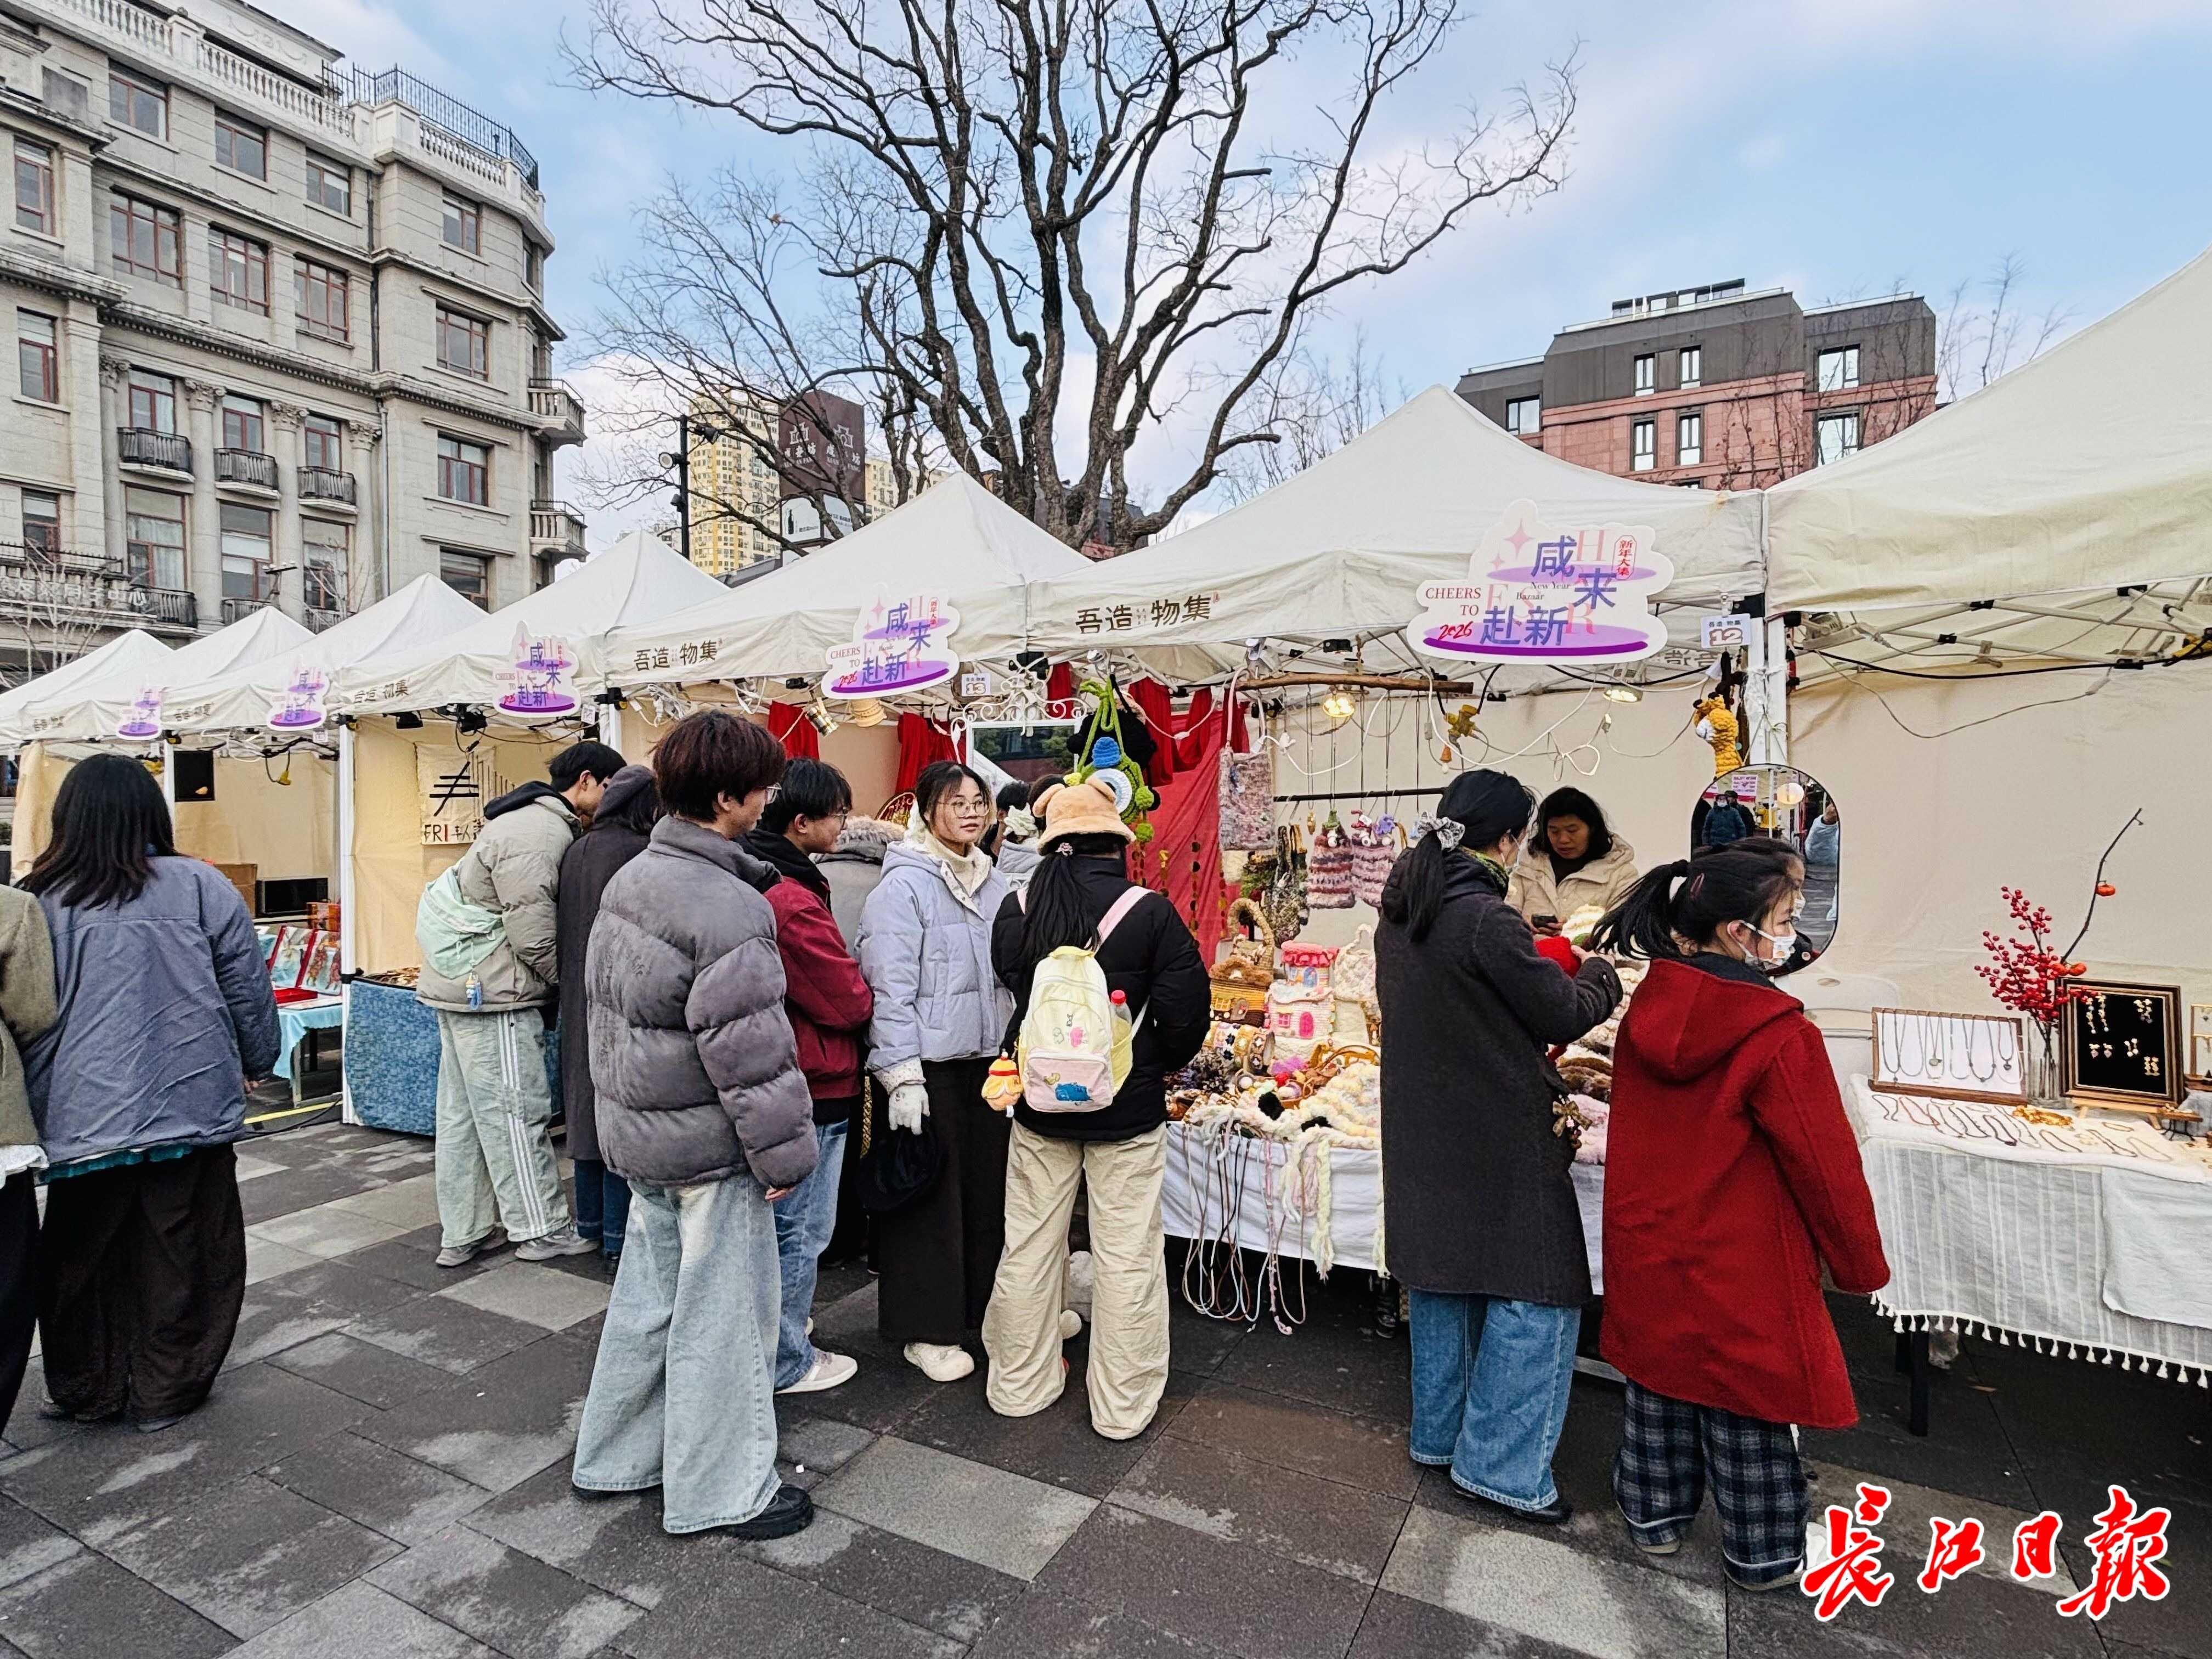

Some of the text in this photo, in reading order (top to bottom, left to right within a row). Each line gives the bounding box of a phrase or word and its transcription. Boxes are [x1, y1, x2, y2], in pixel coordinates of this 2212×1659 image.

[1426, 587, 1481, 600] CHEERS
[1516, 592, 1545, 600] Bazaar
[1075, 604, 1133, 634] 吾造
[1151, 594, 1211, 628] 物集
[1460, 605, 1479, 616] TO
[1437, 620, 1474, 641] 2026
[1479, 605, 1569, 646] 赴新
[1709, 627, 1743, 646] 12
[634, 646, 670, 672] 吾造
[679, 639, 718, 666] 物集
[831, 646, 860, 659] CHEERS
[849, 658, 860, 668] TO
[861, 652, 908, 686] 赴新
[966, 682, 986, 695] 13
[424, 824, 448, 843] FRI
